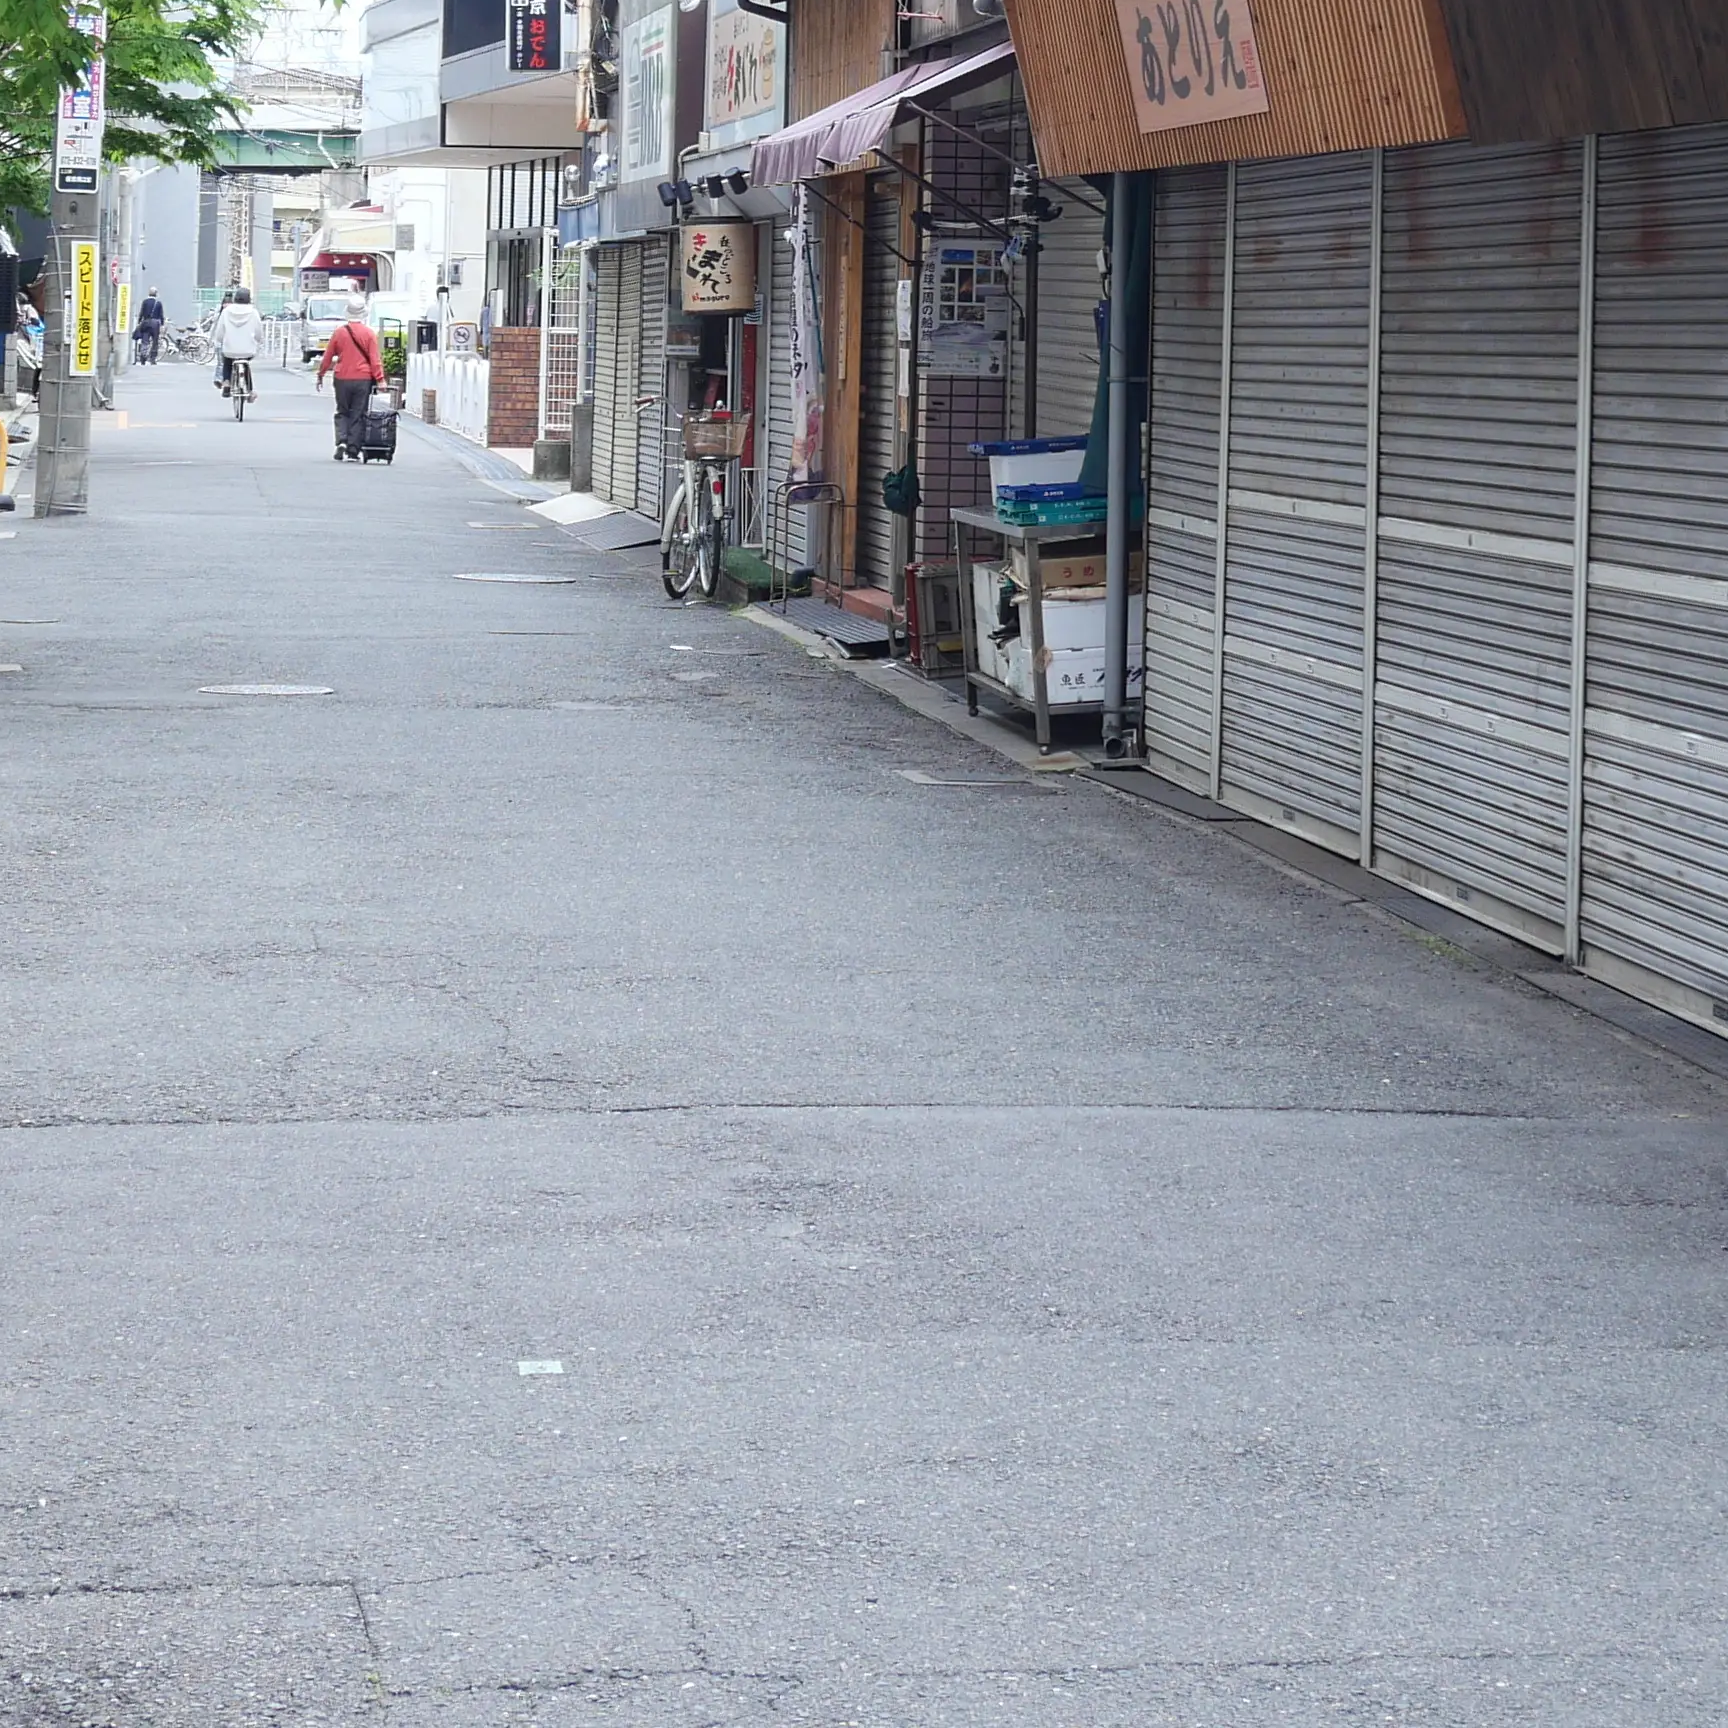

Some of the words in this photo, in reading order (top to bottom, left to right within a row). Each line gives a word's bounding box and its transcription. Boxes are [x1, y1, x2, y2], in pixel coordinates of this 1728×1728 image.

[78, 250, 93, 365] スピード落とせ
[1062, 564, 1095, 579] うめ
